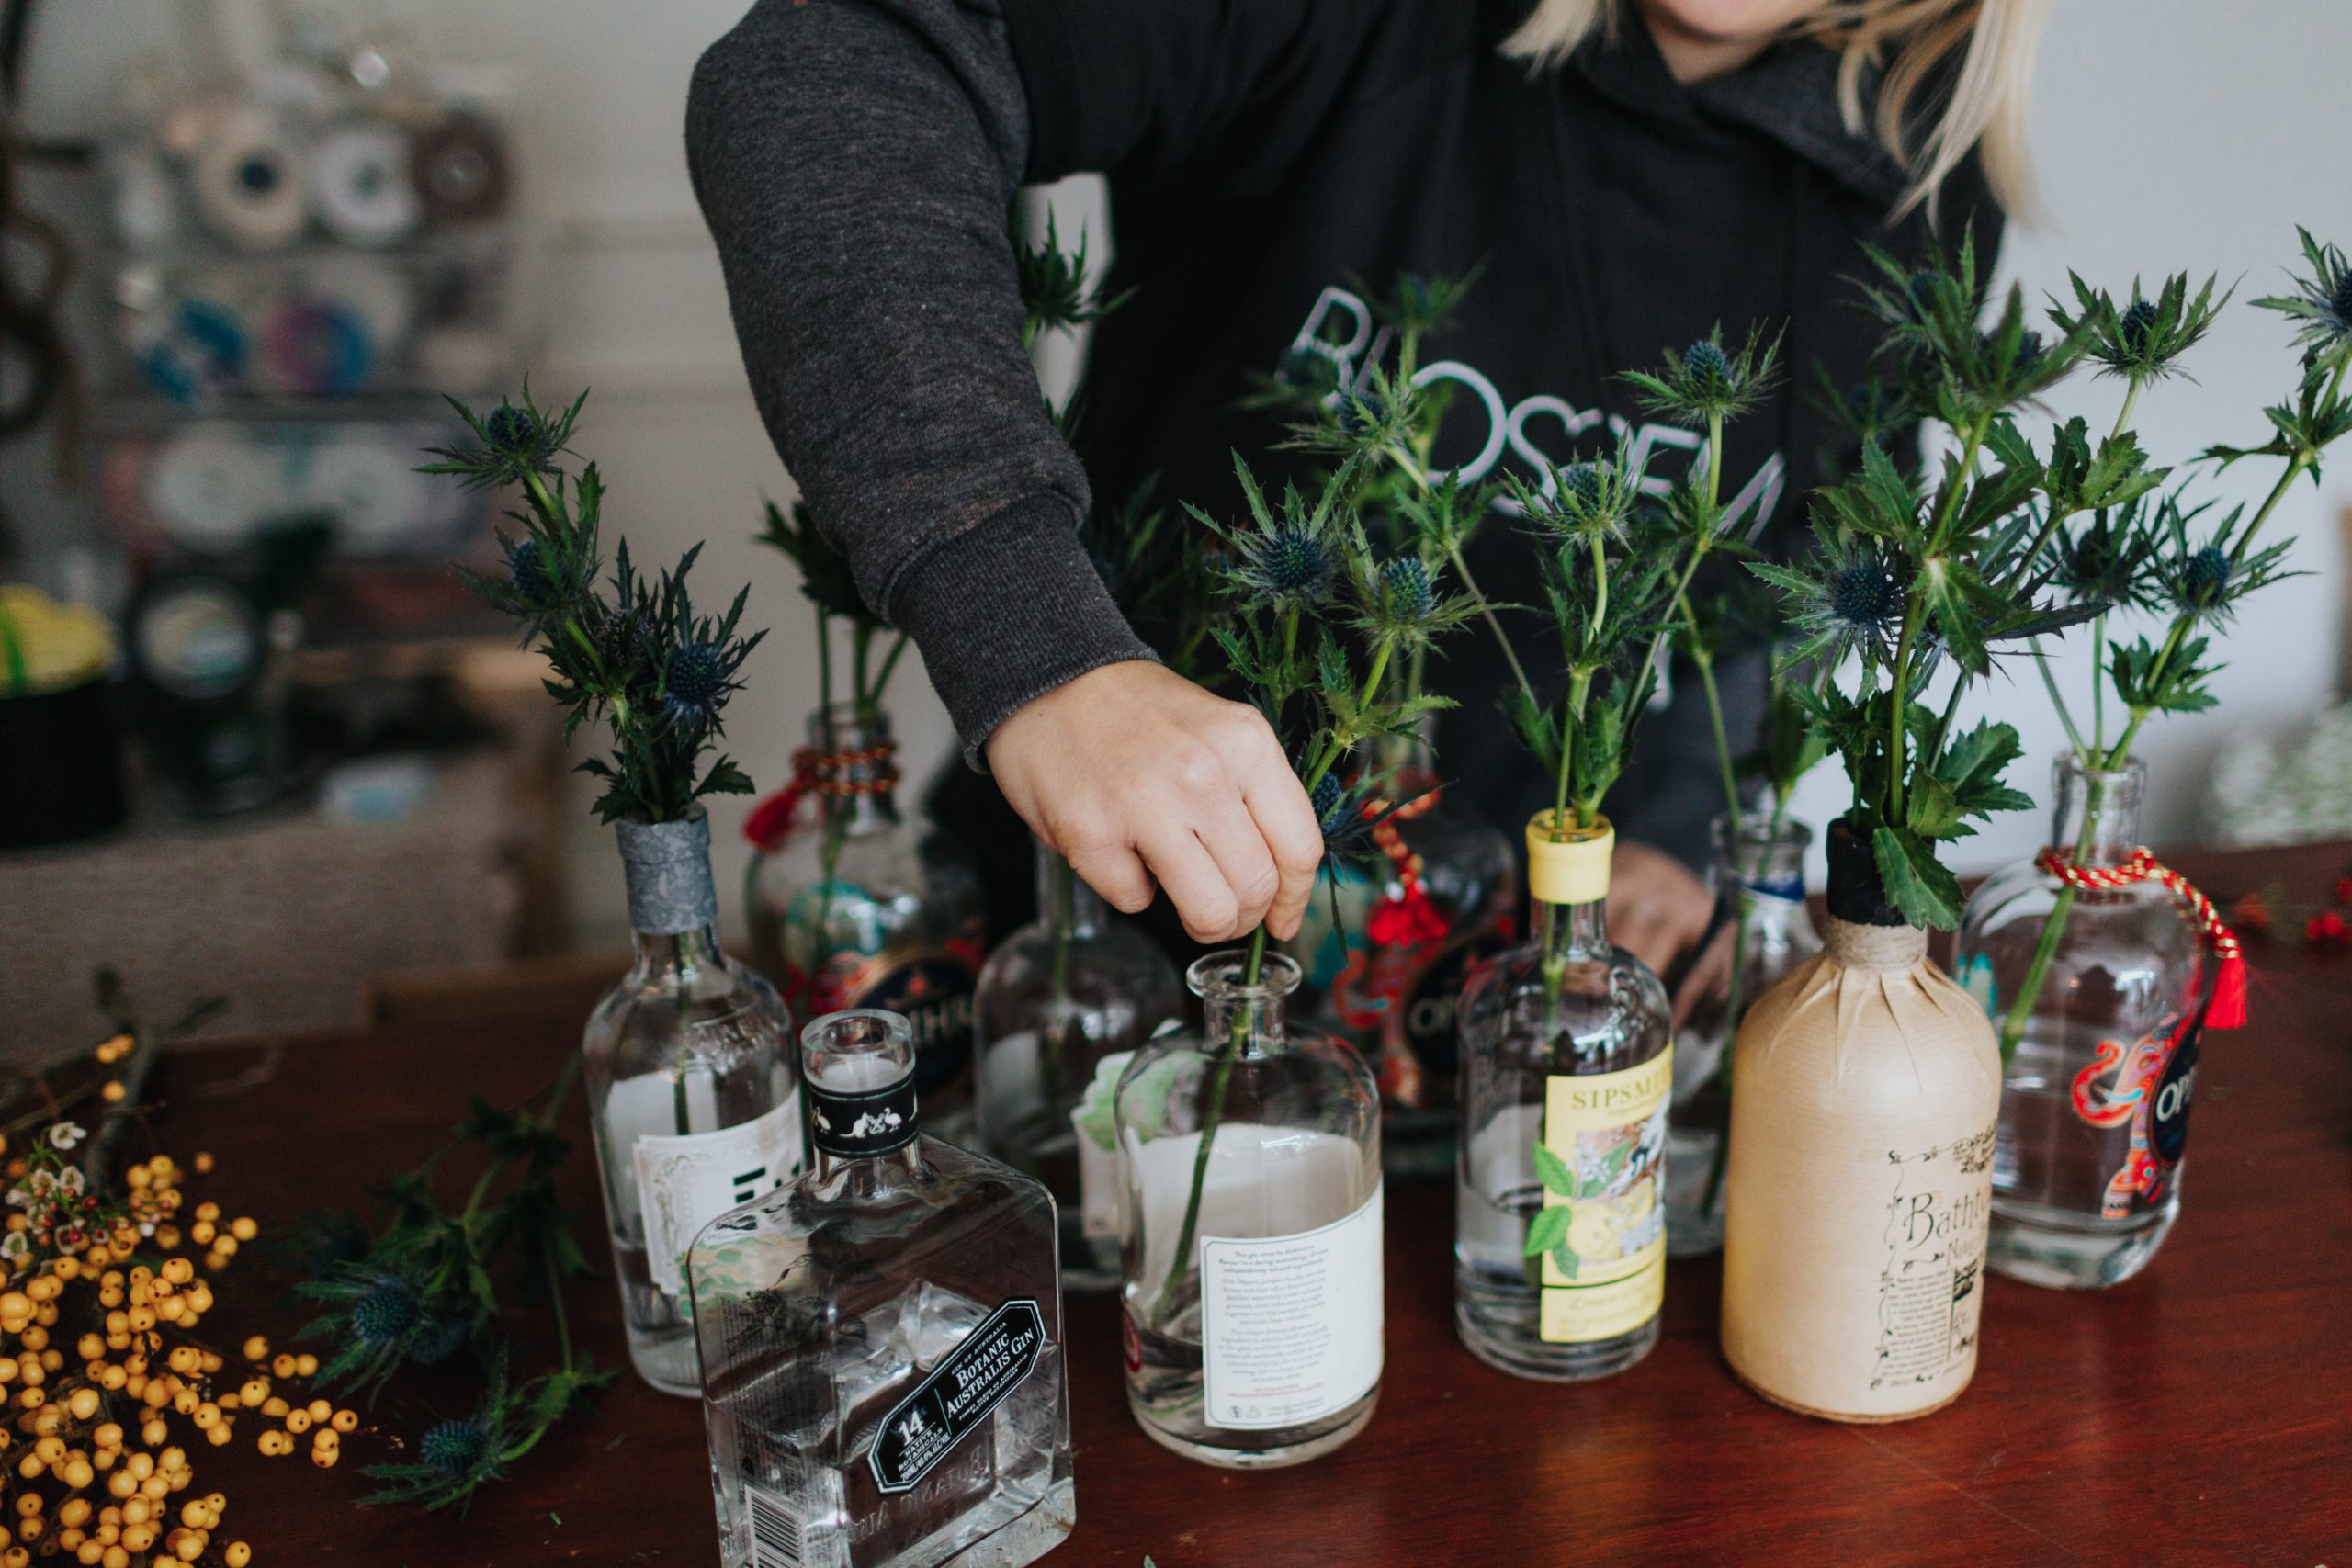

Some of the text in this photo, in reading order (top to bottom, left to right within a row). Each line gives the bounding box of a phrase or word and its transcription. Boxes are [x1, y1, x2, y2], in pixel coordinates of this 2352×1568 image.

[951, 1321, 1007, 1375] GIN OF AUSTRALIA
[956, 1332, 1010, 1390] BOTANIC
[946, 1327, 1035, 1419] AUSTRALIS GIN
[898, 1427, 944, 1472] BOTANICALS
[899, 1410, 926, 1447] 14
[904, 1429, 933, 1458] NATIVE
